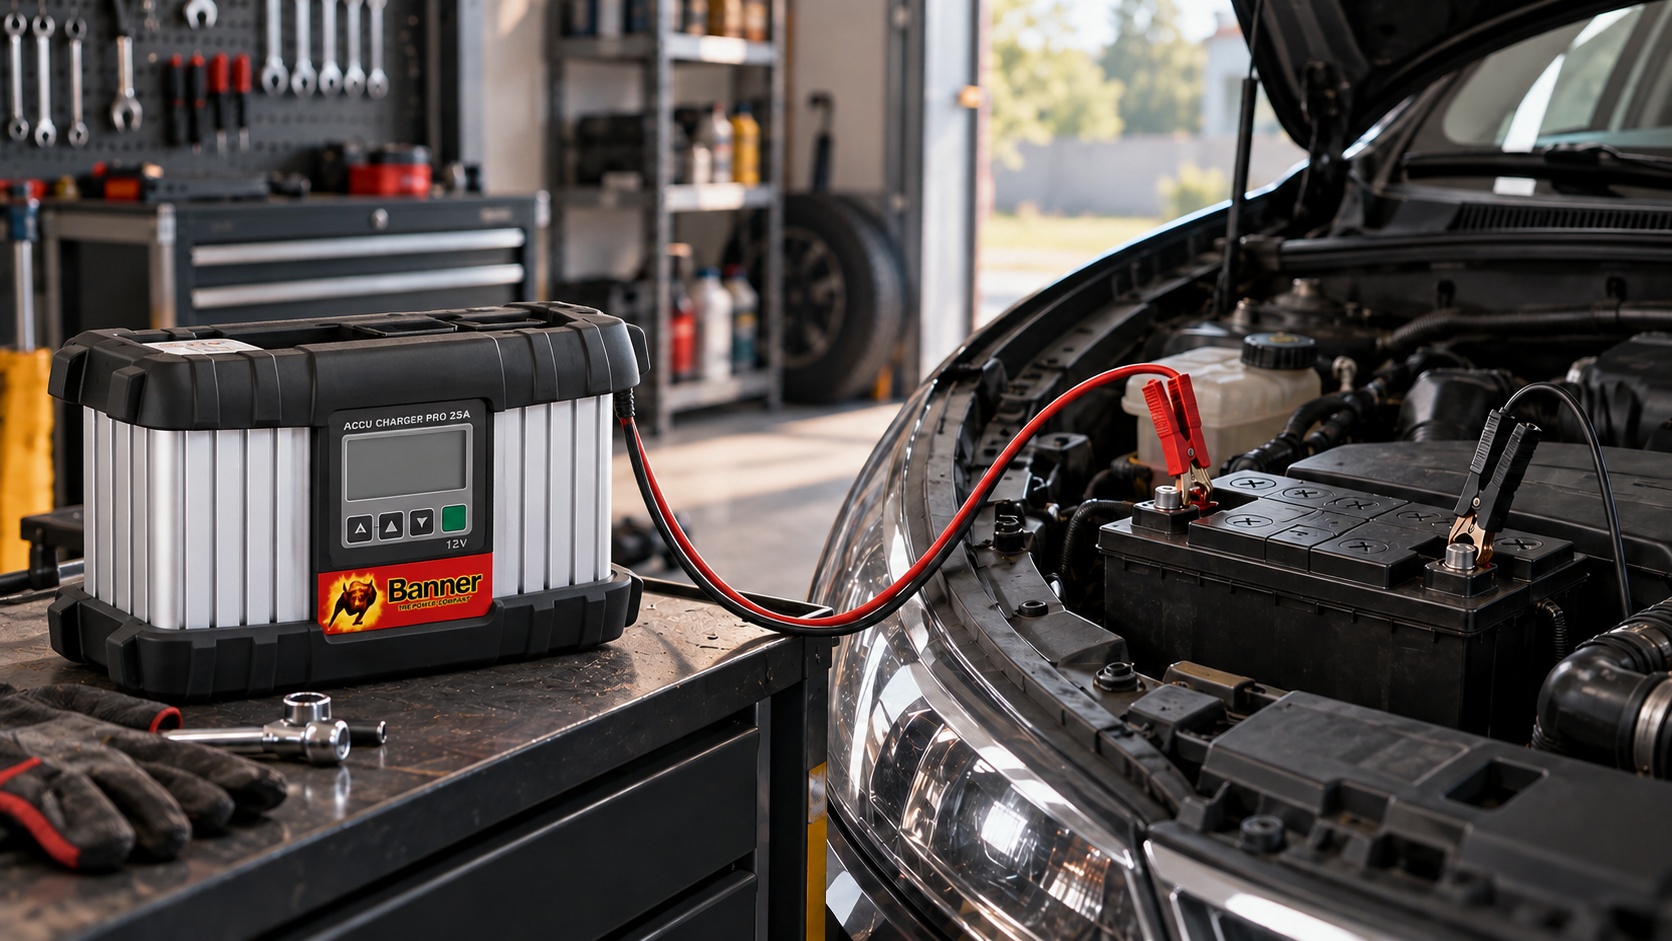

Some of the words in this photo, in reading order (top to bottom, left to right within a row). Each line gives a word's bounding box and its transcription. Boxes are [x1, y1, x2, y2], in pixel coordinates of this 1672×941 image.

[343, 420, 373, 431] ACCU
[375, 415, 423, 428] CHARGER
[426, 412, 447, 422] PRO
[446, 539, 467, 549] 12V
[388, 574, 483, 604] Banner
